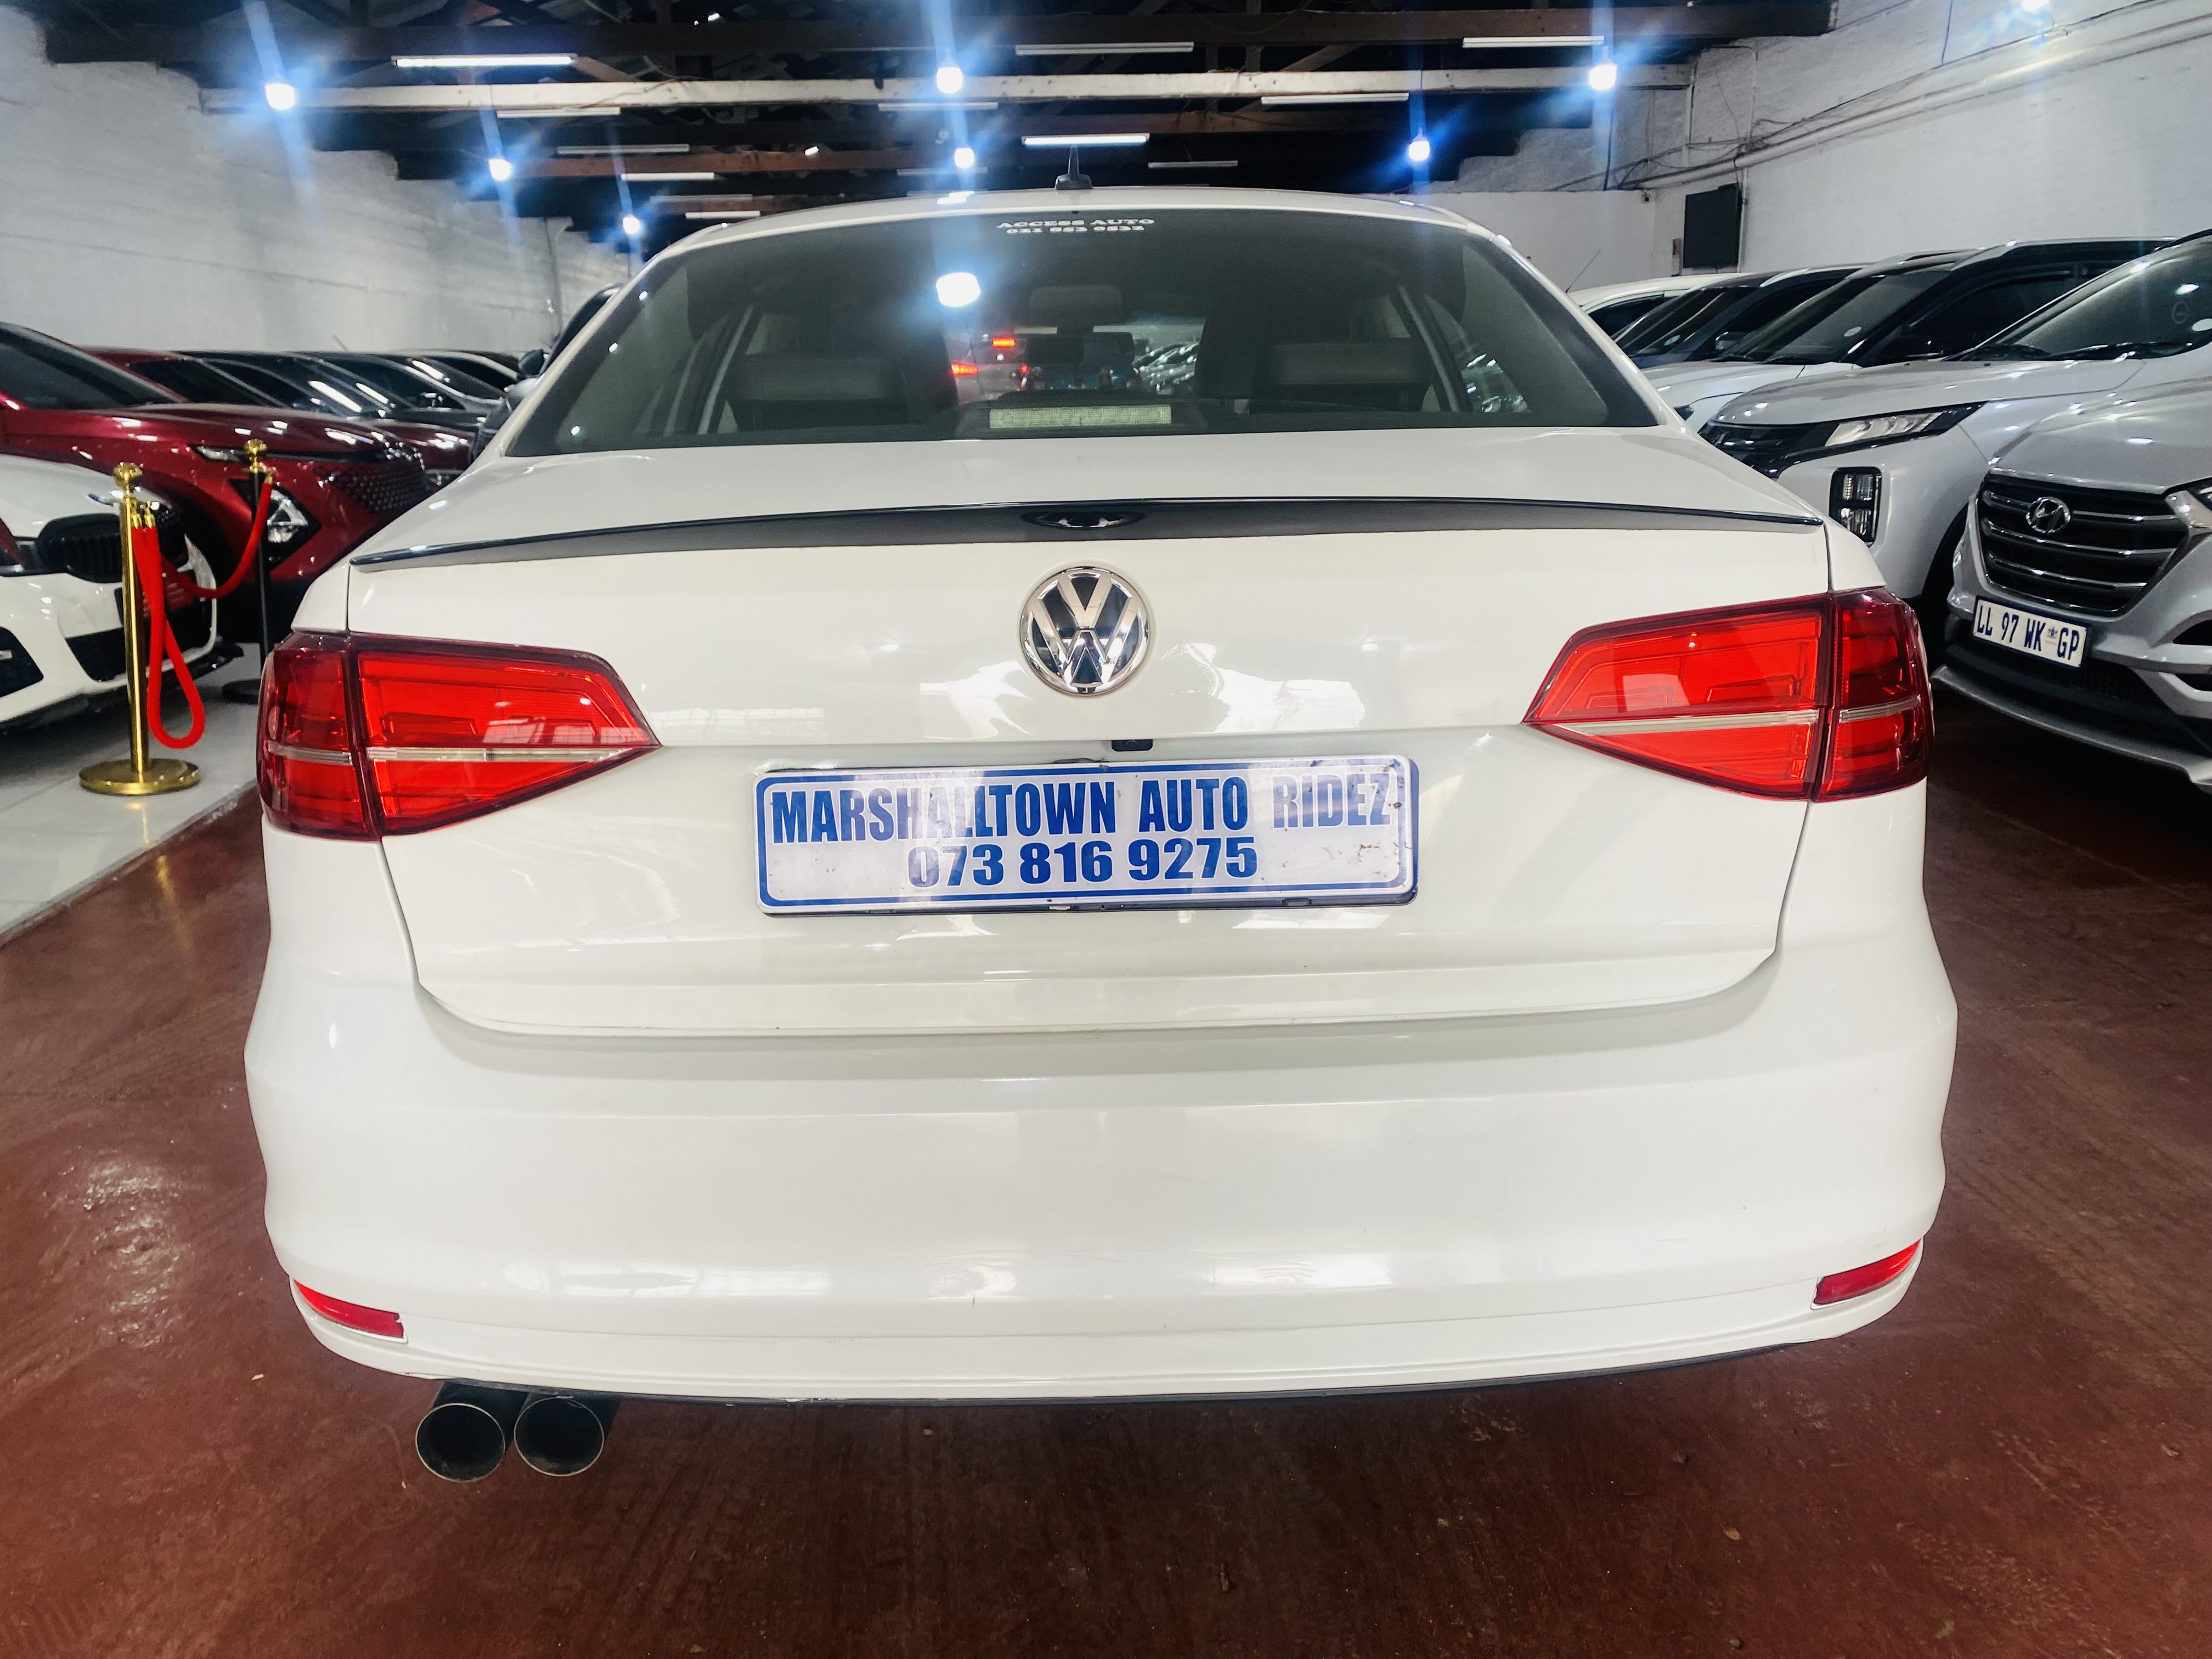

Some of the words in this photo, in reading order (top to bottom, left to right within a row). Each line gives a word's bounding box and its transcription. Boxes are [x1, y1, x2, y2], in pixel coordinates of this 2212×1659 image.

[996, 219, 1085, 228] ACCESS
[1977, 605, 1993, 636] LL
[2001, 612, 2019, 643] 97
[2024, 618, 2046, 652] WK
[2057, 627, 2080, 661] GP
[771, 781, 1116, 844] MARSHALLTOWN
[1138, 776, 1248, 833] AUTO
[1273, 772, 1391, 829] RIDEZ
[908, 844, 1004, 888] 073
[1020, 840, 1113, 884] 816
[1128, 836, 1257, 881] 9275
